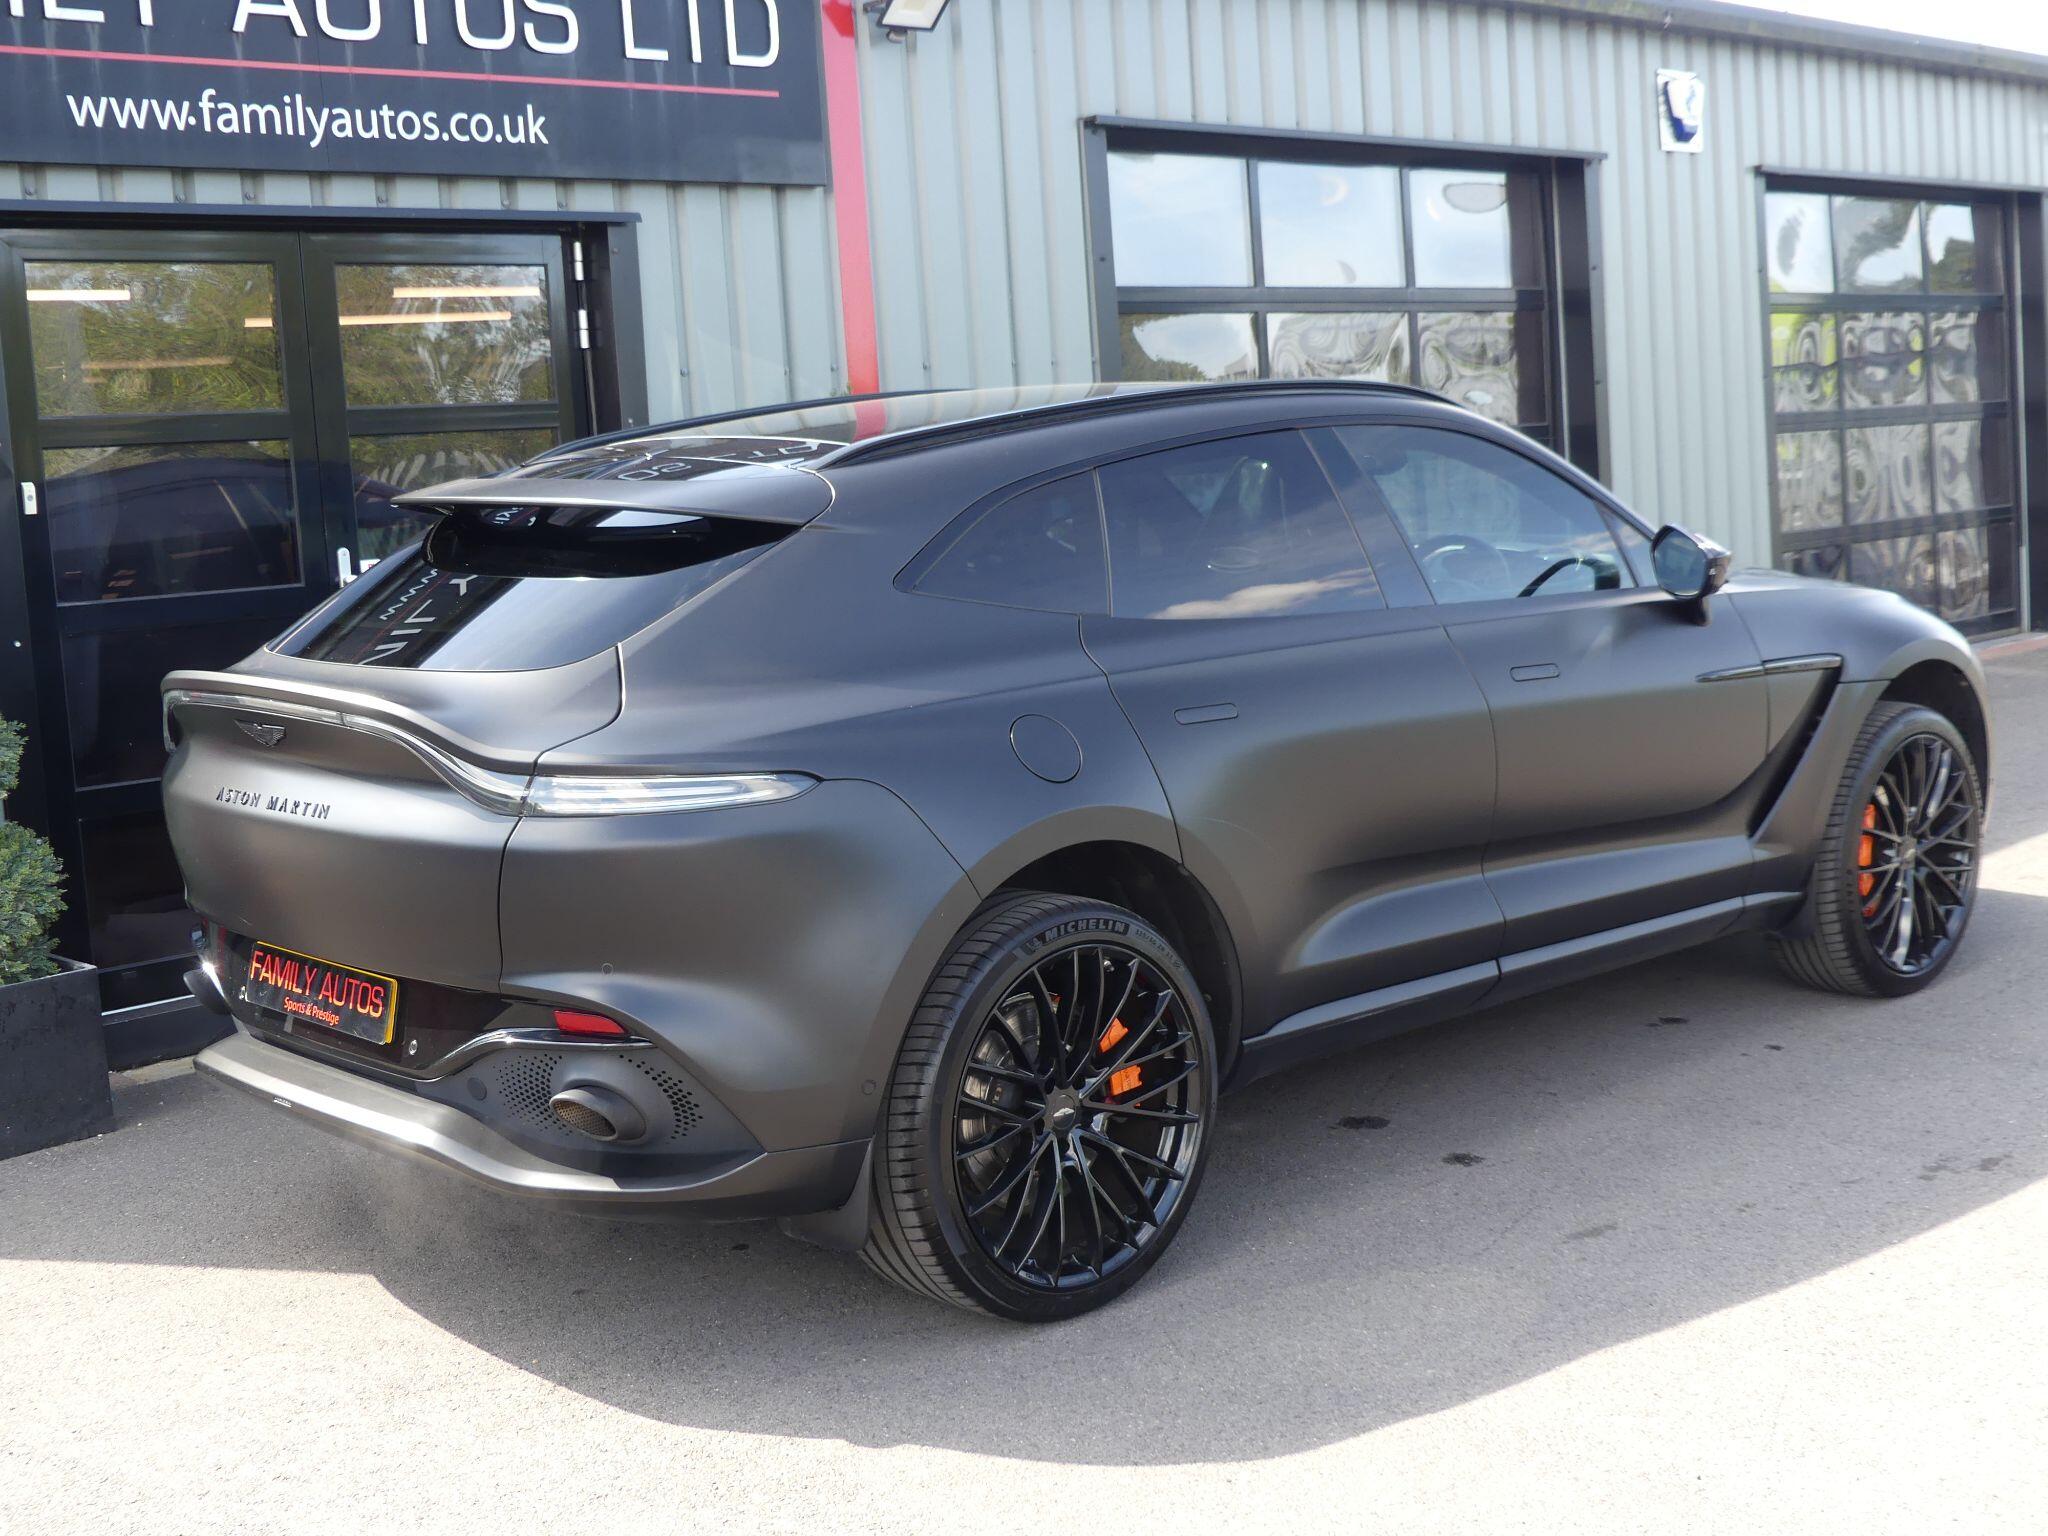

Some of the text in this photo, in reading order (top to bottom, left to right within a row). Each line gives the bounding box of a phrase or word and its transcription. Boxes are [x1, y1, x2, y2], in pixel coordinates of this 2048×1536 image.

[66, 88, 549, 148] www.familyautos.co.uk
[216, 786, 331, 820] ASTON MARTIN
[1044, 918, 1127, 941] MICHELIN
[250, 950, 385, 1018] FAMILY AUTOS
[284, 996, 340, 1026] Sports & Prestige
